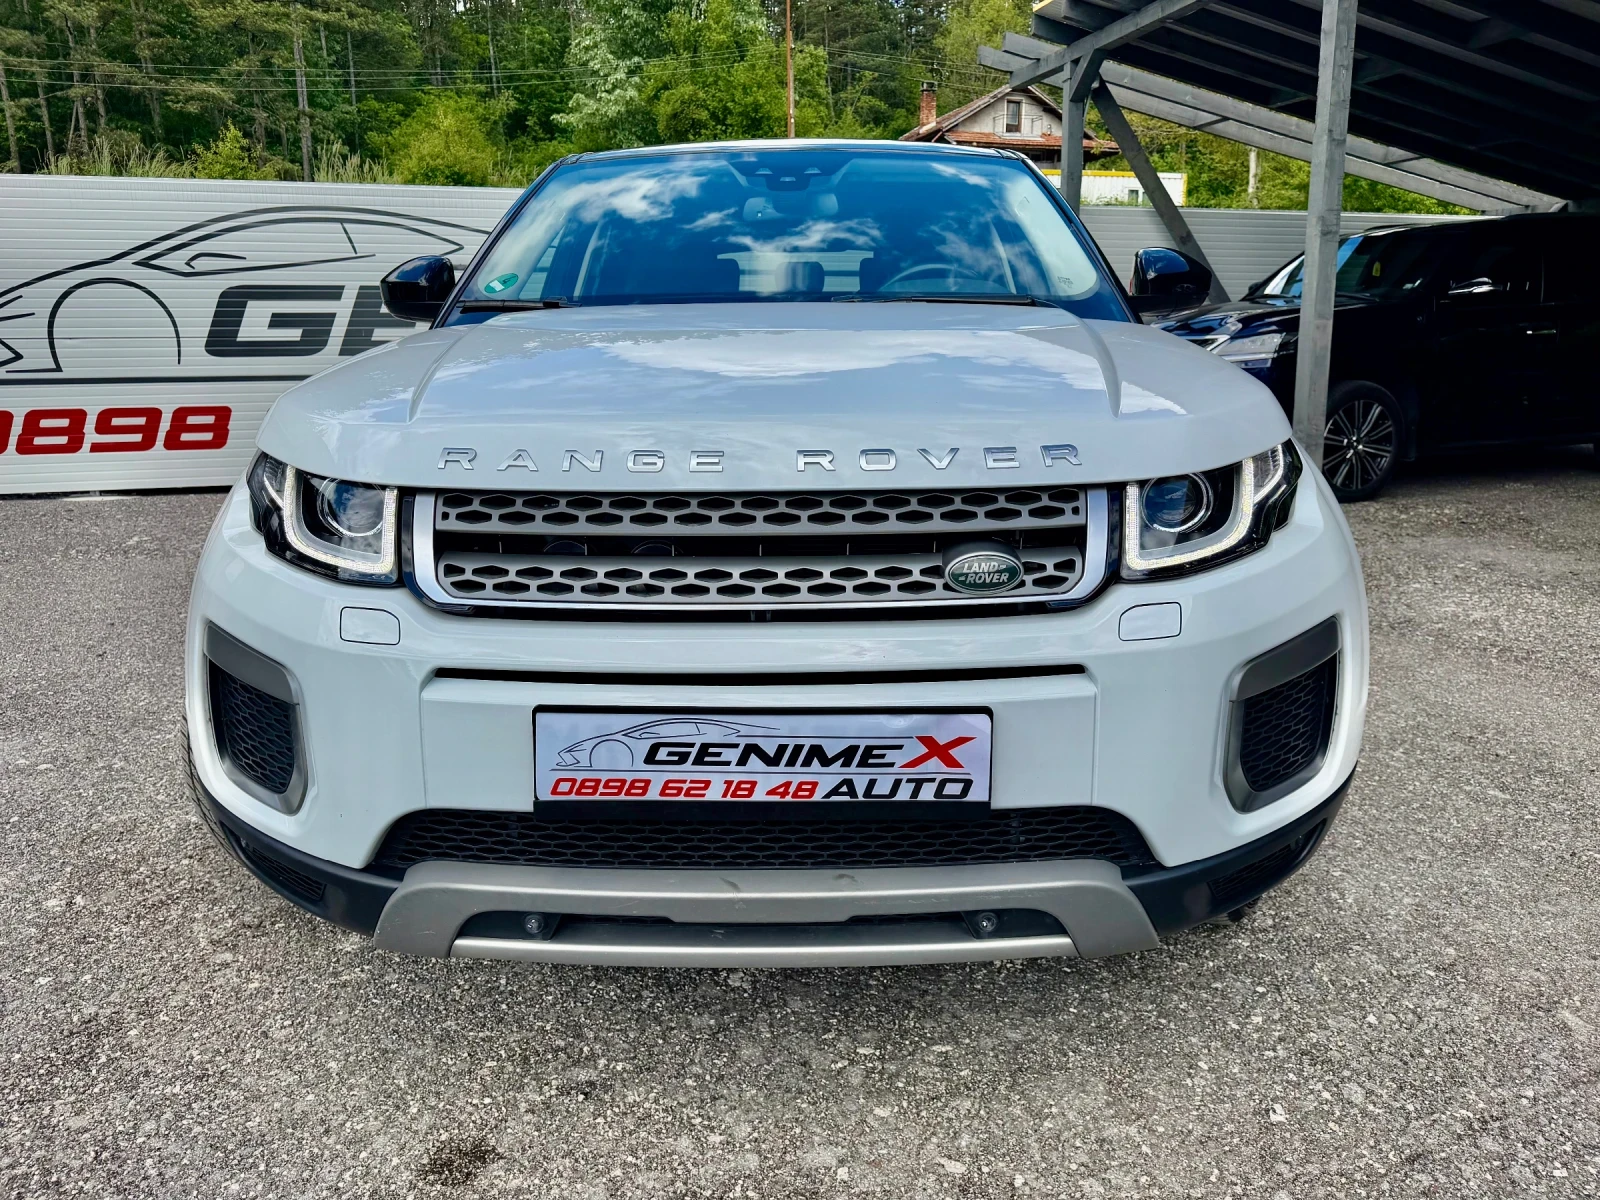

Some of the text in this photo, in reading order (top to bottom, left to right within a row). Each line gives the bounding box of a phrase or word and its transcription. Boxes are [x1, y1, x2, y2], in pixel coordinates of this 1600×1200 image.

[0, 405, 232, 456] 898
[437, 443, 1083, 473] RANGE ROVER
[962, 562, 999, 573] LAND
[965, 572, 1010, 584] ROVER
[643, 735, 978, 769] GENIMEX
[549, 777, 819, 800] 0898 62 18 48
[821, 777, 975, 800] AUTO
